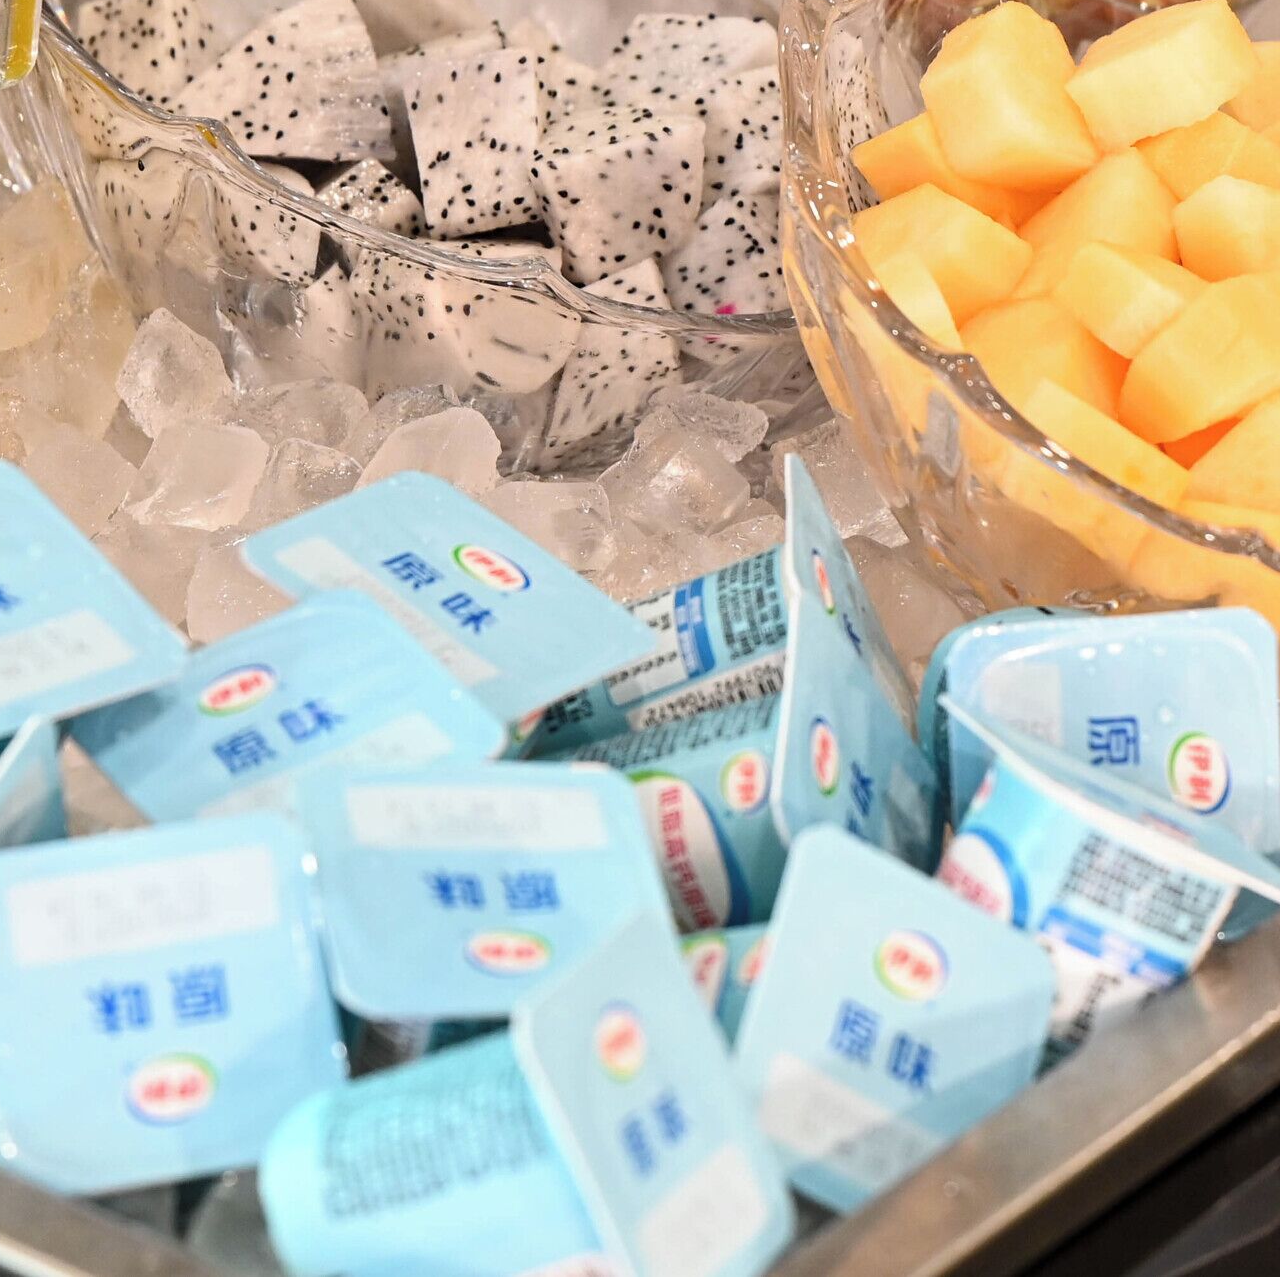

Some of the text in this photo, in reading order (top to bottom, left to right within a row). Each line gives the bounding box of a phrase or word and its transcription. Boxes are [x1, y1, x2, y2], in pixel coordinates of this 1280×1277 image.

[381, 551, 500, 635] 原味
[462, 546, 522, 589] 伊利
[206, 670, 265, 708] 伊利
[212, 697, 349, 776] 原味
[1087, 714, 1143, 767] 原
[1185, 743, 1216, 805] 伊利
[423, 866, 563, 913] 原味
[86, 963, 233, 1036] 原味
[827, 994, 942, 1096] 原味
